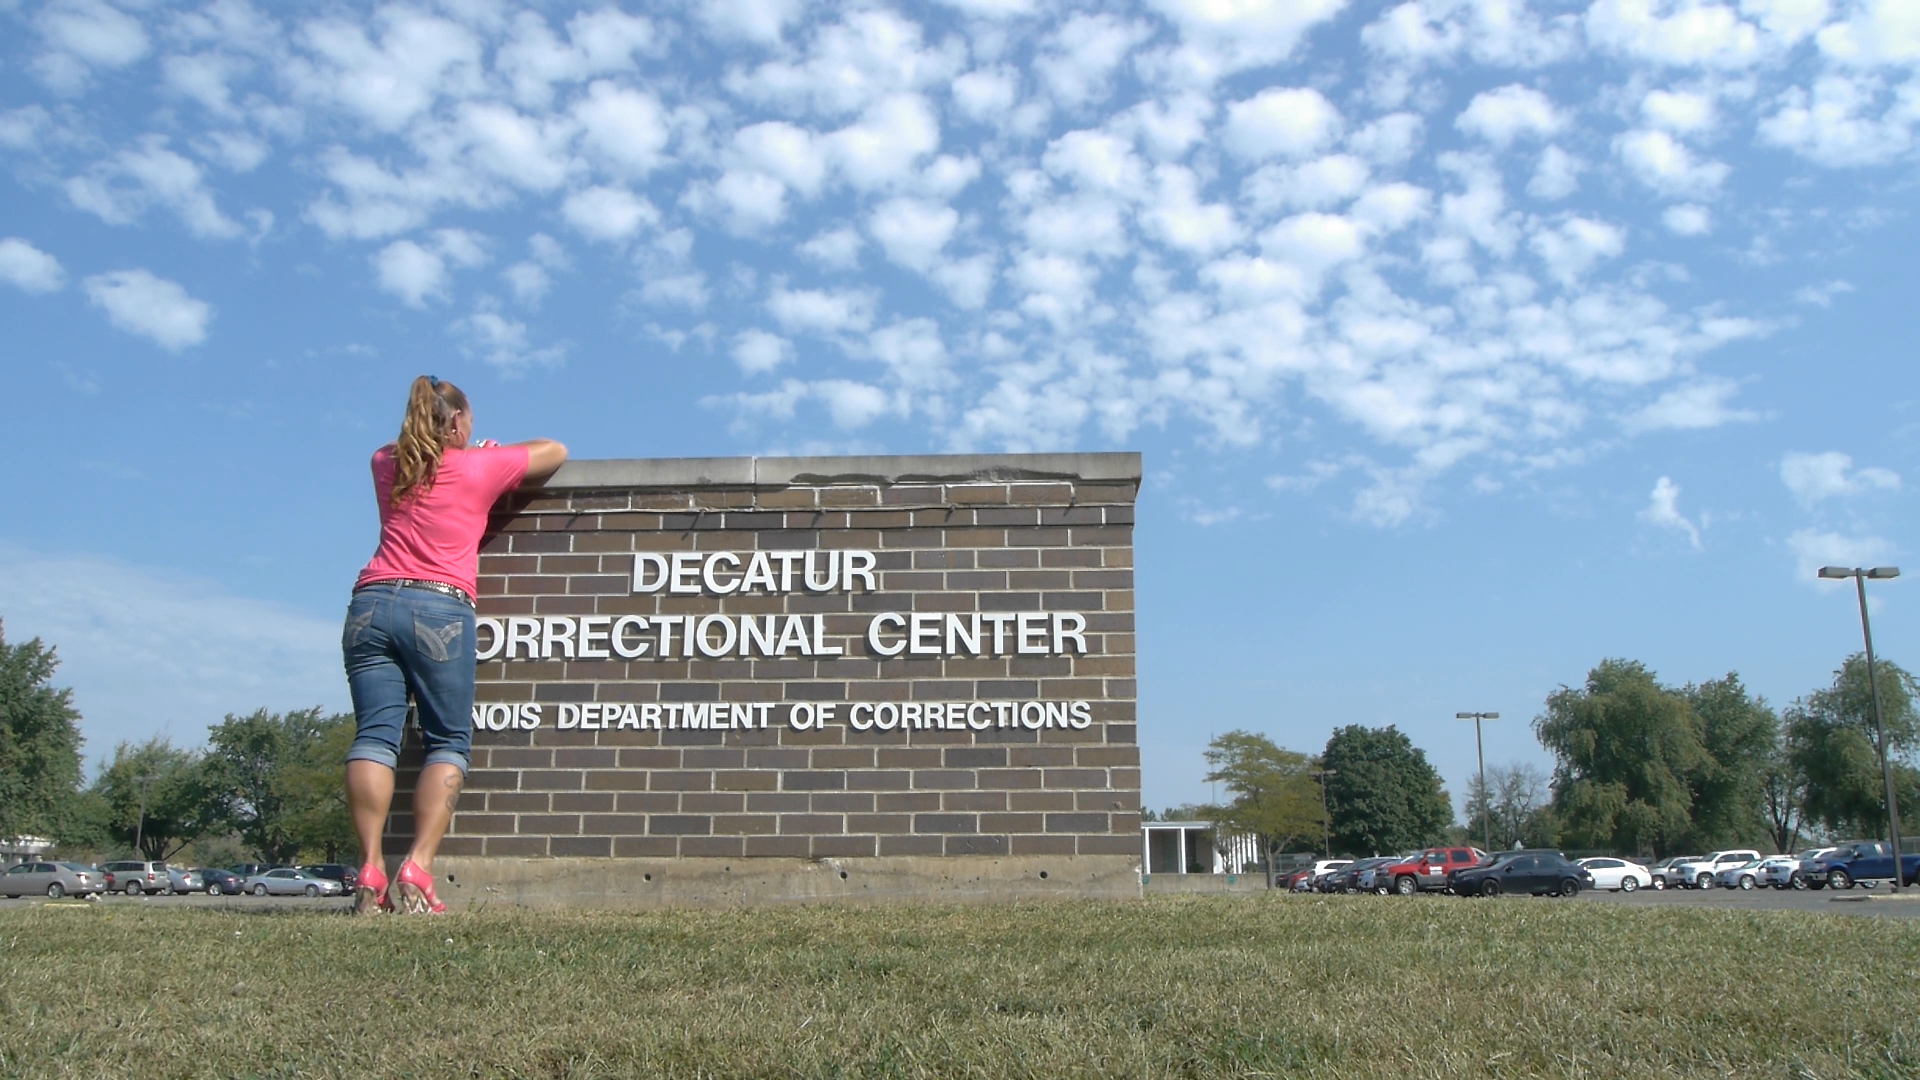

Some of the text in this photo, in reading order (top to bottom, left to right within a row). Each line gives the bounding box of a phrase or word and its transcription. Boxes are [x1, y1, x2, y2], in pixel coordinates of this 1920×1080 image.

[632, 550, 877, 593] DECATUR
[475, 612, 1087, 660] ORRECTIONAL CENTER
[557, 702, 775, 730] DEPARTMENT
[789, 702, 836, 730] OF
[850, 701, 1092, 730] CORRECTIONS
